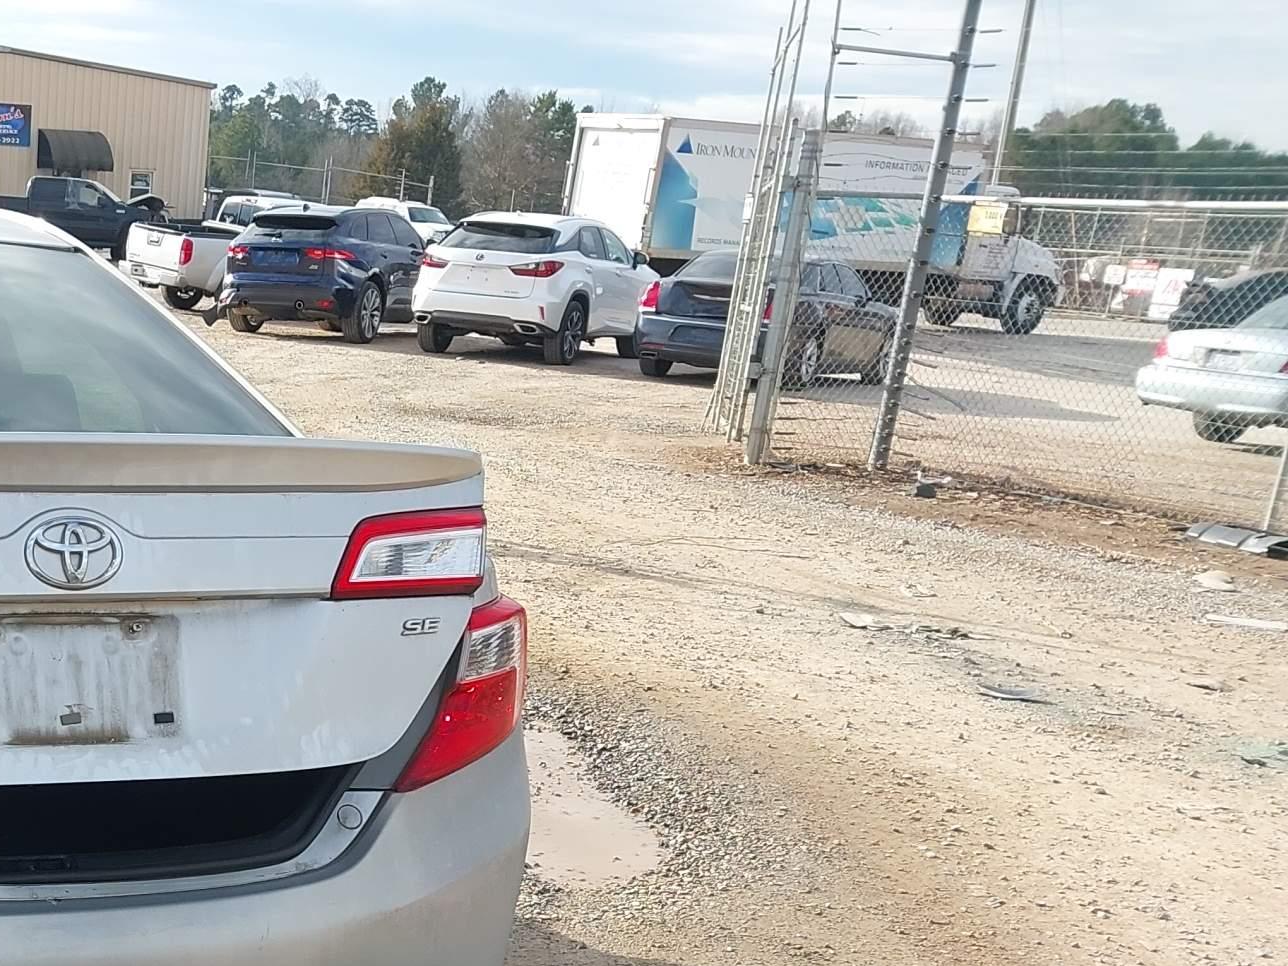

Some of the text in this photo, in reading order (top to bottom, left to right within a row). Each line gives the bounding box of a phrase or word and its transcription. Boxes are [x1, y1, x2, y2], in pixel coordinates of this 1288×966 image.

[696, 142, 757, 159] IRON MOUN
[865, 160, 925, 173] INFORMATION
[400, 616, 441, 636] SE
